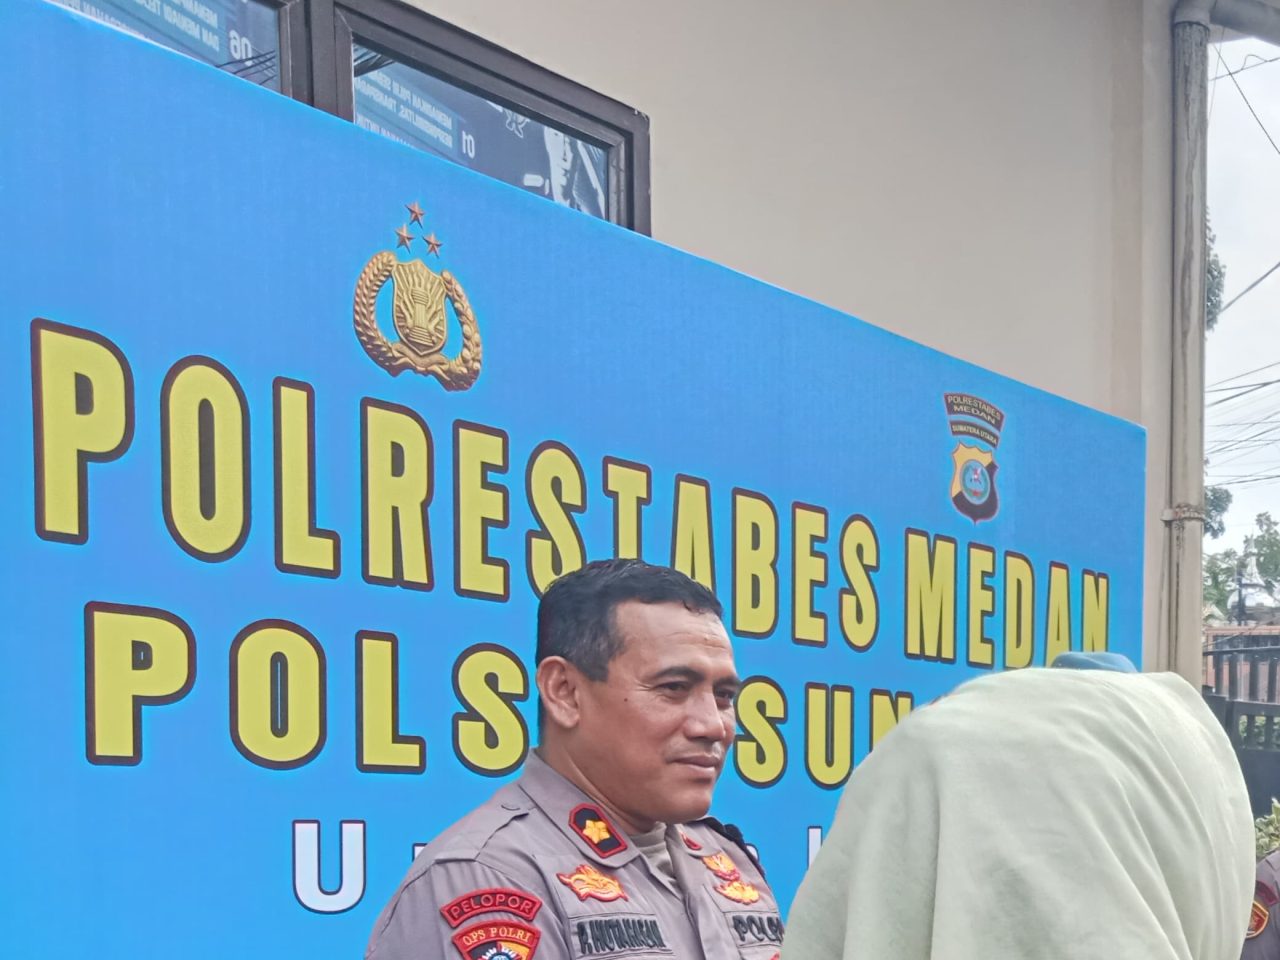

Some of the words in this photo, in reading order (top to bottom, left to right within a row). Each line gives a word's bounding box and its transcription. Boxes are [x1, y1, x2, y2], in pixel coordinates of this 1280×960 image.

[947, 395, 1001, 421] POLRESTABES
[953, 404, 996, 425] MEDAN
[30, 317, 880, 652] POLRESTABES
[904, 527, 1109, 667] MEDAN
[84, 600, 530, 777] POLS
[450, 893, 534, 919] PELOPOR
[462, 929, 486, 946] OPS
[489, 926, 534, 943] POLRI
